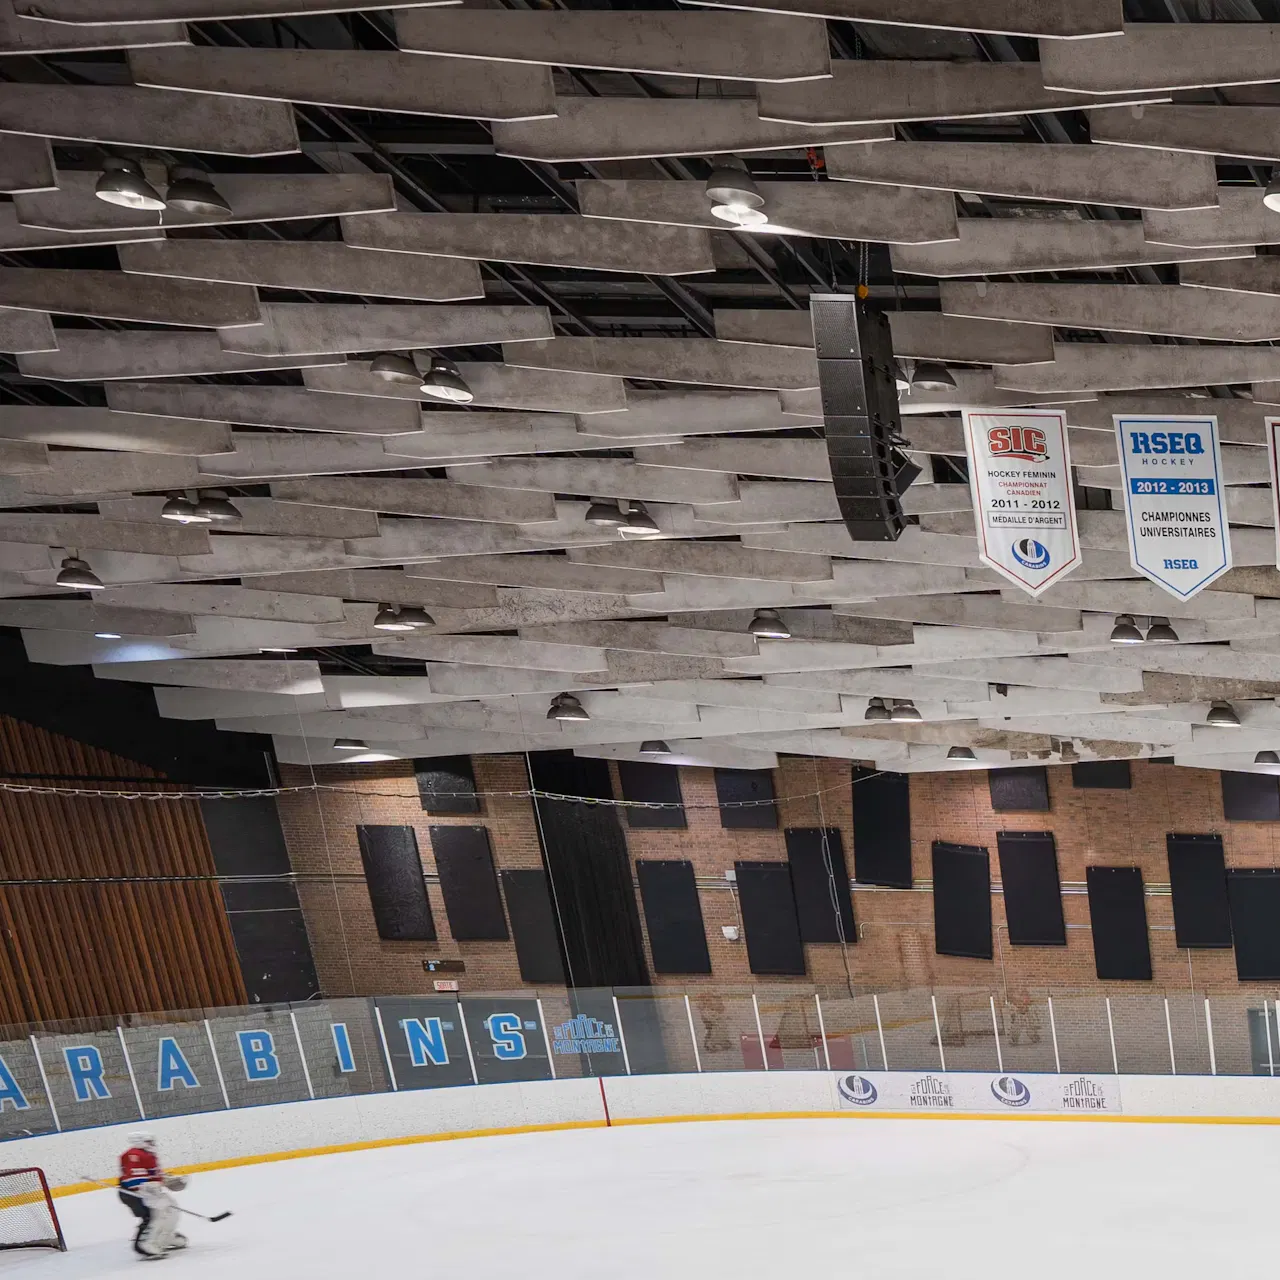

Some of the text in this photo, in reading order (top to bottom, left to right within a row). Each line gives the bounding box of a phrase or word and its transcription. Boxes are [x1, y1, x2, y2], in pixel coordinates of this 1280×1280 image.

[988, 426, 1046, 454] SIC
[1130, 432, 1204, 454] RSEQ
[1023, 470, 1056, 478] FÉMININ
[1137, 482, 1167, 493] 2012
[1179, 482, 1209, 493] 2013
[992, 499, 1019, 508] 2011
[1032, 501, 1060, 509] 2012
[1142, 512, 1210, 522] CHAMPIONNES
[1140, 527, 1216, 537] UNIVERSITAIRES
[1163, 559, 1198, 569] RSEQ
